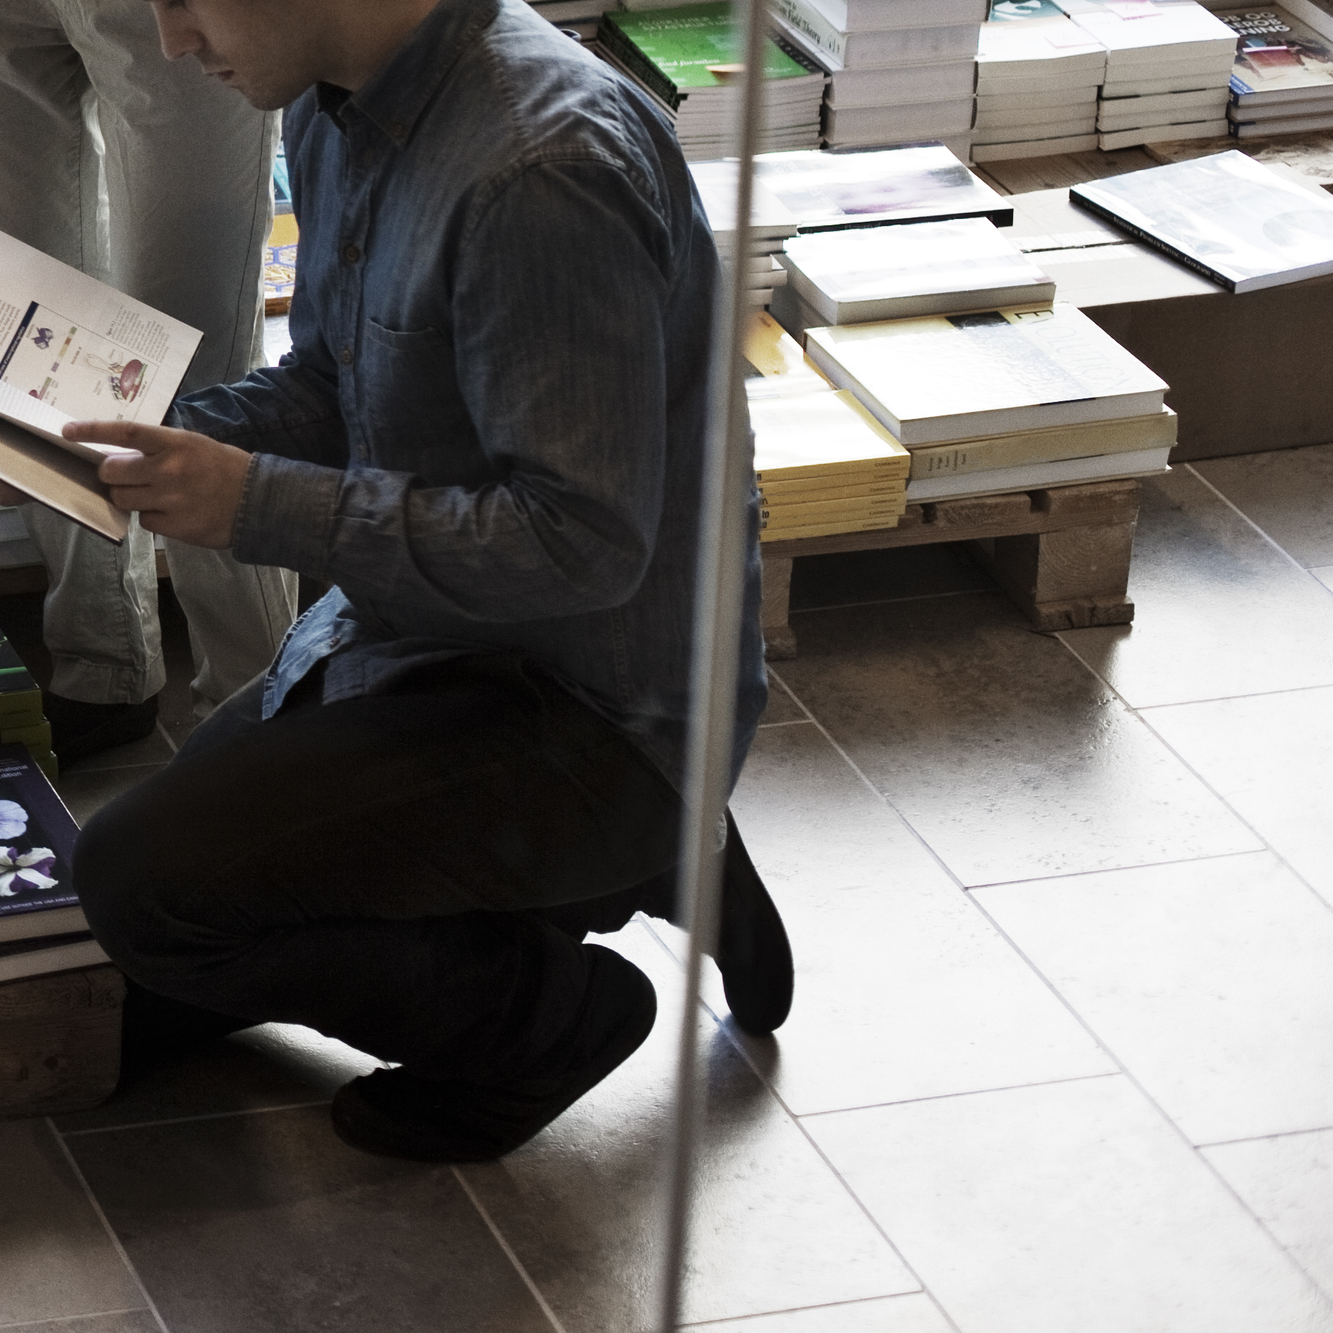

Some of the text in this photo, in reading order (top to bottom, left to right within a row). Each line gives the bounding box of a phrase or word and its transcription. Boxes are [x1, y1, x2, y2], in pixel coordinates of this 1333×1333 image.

[1245, 11, 1276, 20] OG
[802, 19, 821, 45] Theory
[1240, 24, 1291, 35] NING
[1015, 309, 1139, 392] EOLUTION
